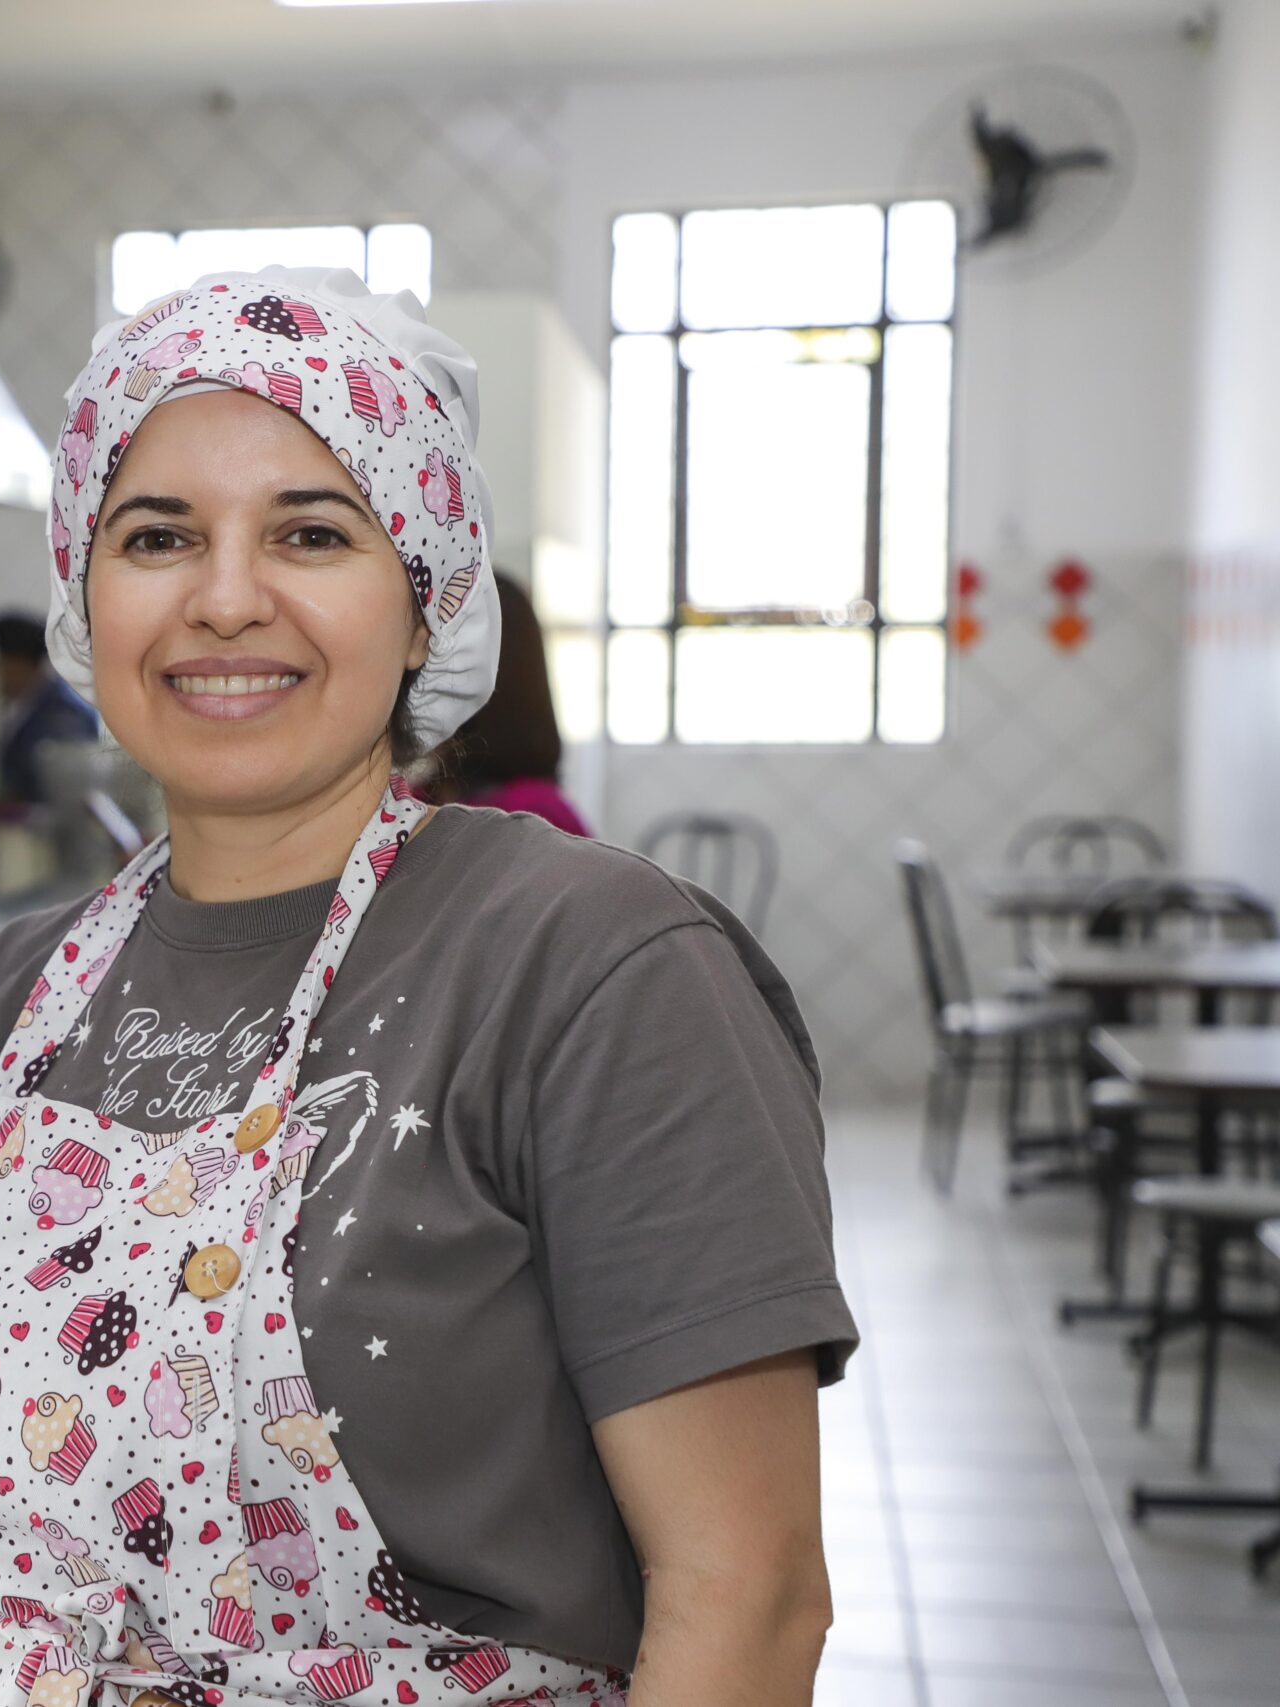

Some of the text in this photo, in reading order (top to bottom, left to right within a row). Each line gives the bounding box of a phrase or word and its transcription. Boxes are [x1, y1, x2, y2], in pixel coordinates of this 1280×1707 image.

[104, 1007, 274, 1073] Raised by
[96, 1056, 240, 1119] the Stars
